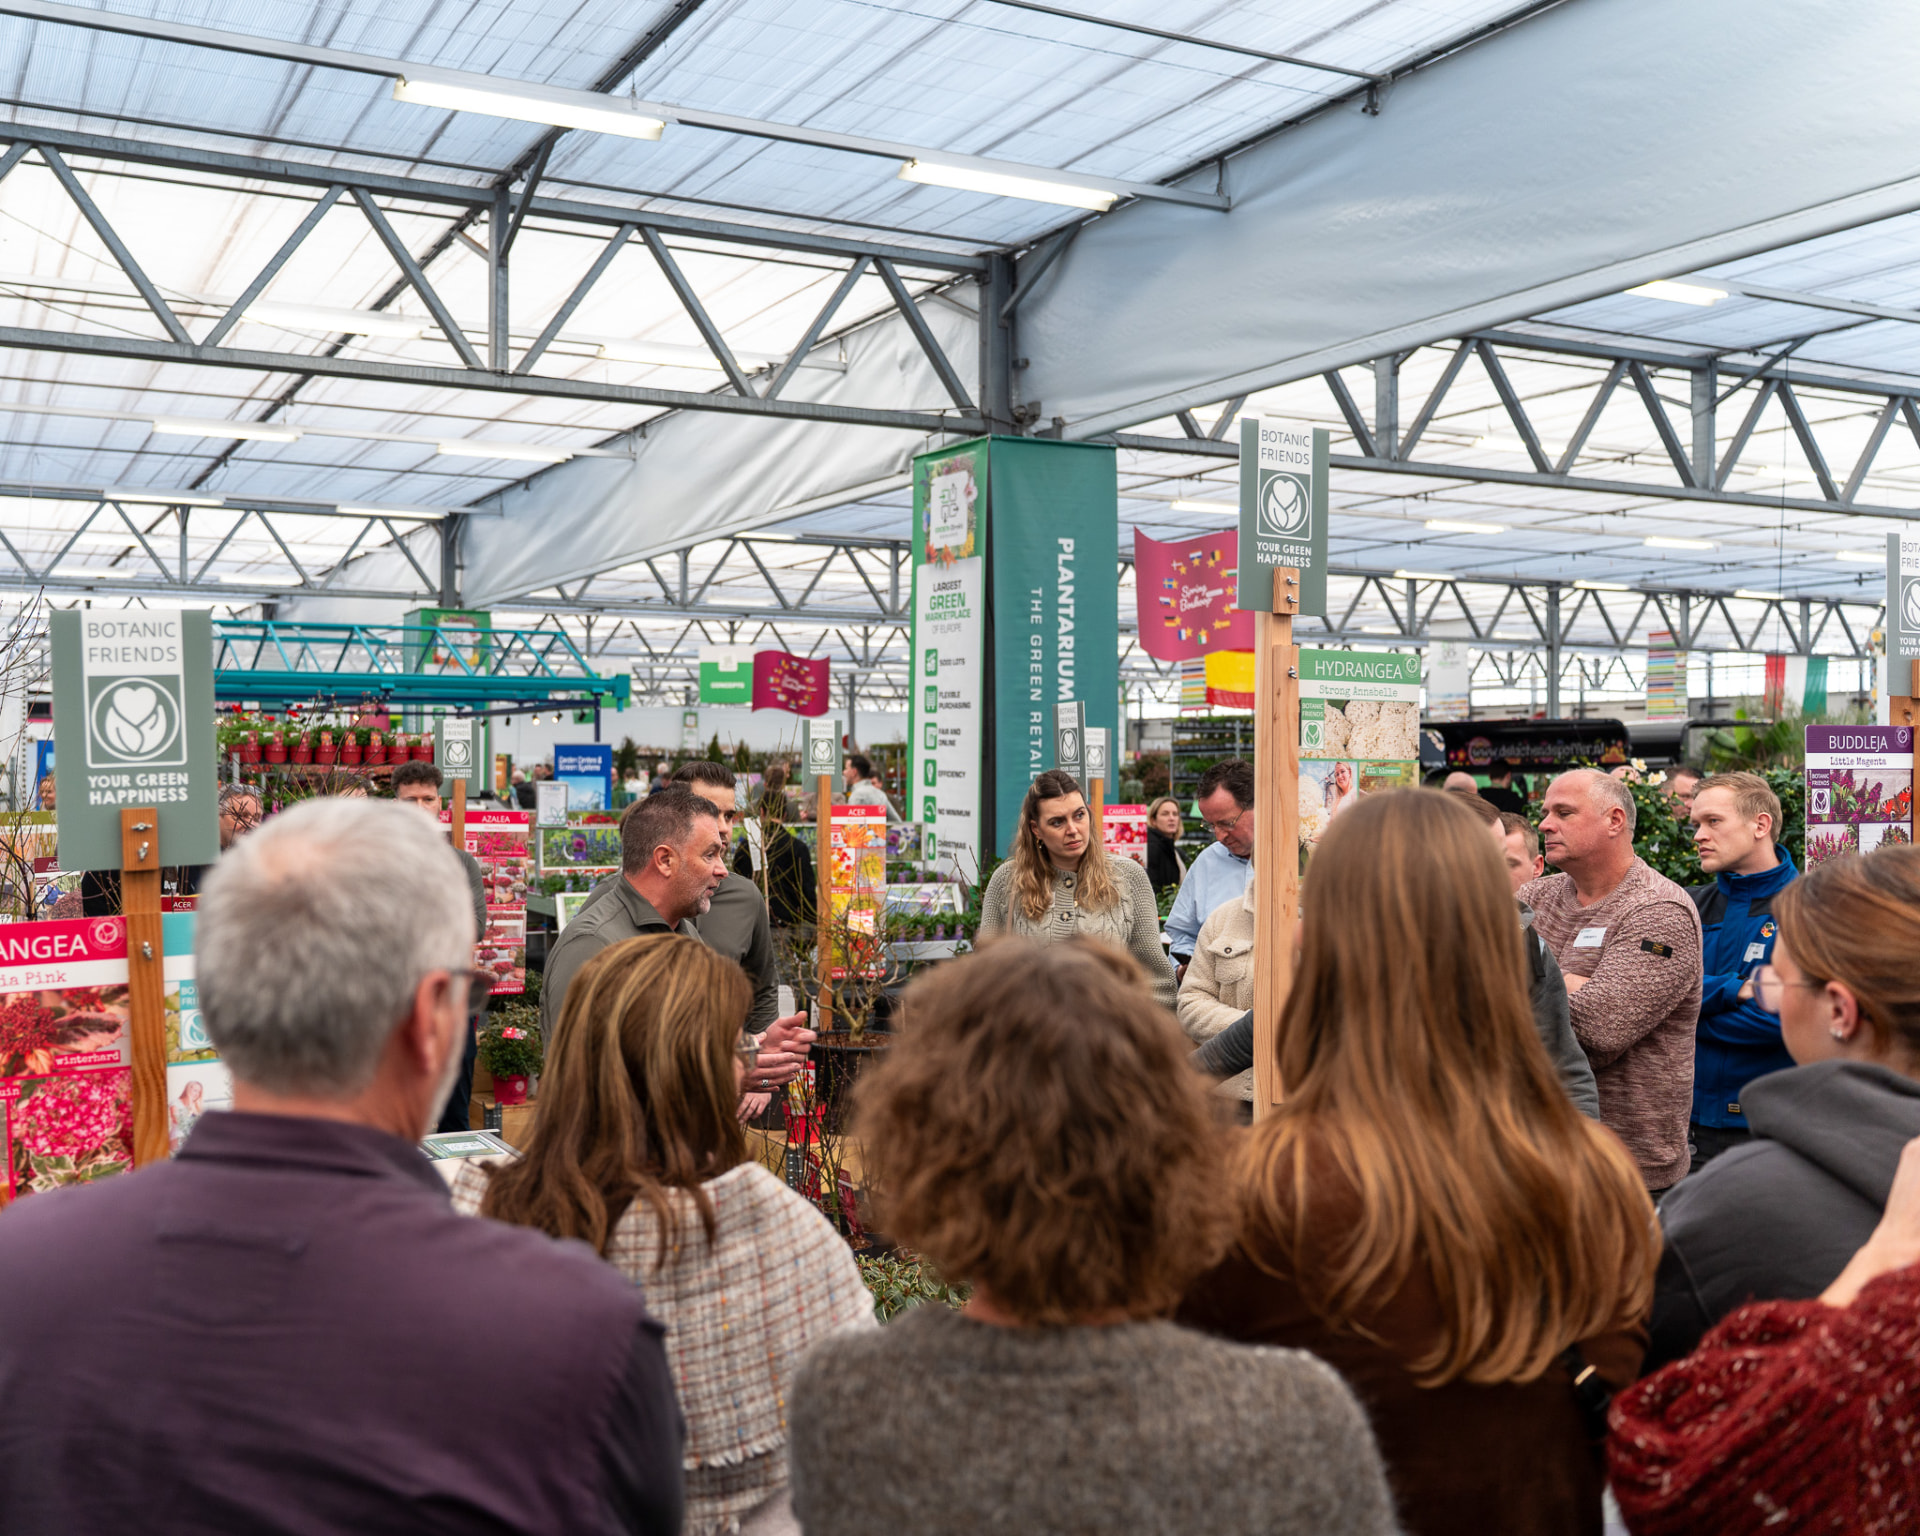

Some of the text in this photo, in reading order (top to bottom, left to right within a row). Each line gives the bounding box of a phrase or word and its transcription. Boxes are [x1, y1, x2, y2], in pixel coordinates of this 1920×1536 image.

[1261, 429, 1310, 448] BOTANIC
[1261, 447, 1310, 465] FRIENDS
[1256, 541, 1312, 556] YOUR GREEN
[1256, 552, 1311, 568] HAPPINESS
[933, 580, 962, 593] LARGEST
[929, 591, 966, 611] GREEN
[925, 608, 972, 622] MARKETPLACE
[1057, 537, 1075, 700] PLANTARIUM
[87, 621, 176, 639] BOTANIC
[932, 622, 963, 635] OF EUROPE
[1899, 637, 1916, 646] YOUR
[88, 646, 178, 663] FRIENDS
[1315, 660, 1403, 680] HYDRANGEA
[1030, 587, 1043, 780] THE GREEN RETAIL
[938, 691, 961, 699] FLEXIBLE
[1319, 685, 1398, 698] Strong Annabelle
[938, 701, 972, 710] PURCHASING
[1059, 706, 1077, 714] BOTANIC
[1302, 702, 1324, 710] BOTANIC
[1302, 710, 1324, 718] FRIENDS
[938, 728, 949, 736] FAIR
[938, 739, 956, 747] ONLINE
[1829, 735, 1888, 752] BUDDLEJA
[1830, 756, 1887, 767] Little Magenta
[87, 772, 189, 789] YOUR GREEN
[938, 770, 966, 779] EFFICIENCY
[89, 787, 189, 805] HAPPINESS
[847, 808, 866, 816] ACER
[946, 808, 971, 818] MINIMUM
[481, 815, 511, 823] AZALEA
[173, 901, 192, 909] ACER
[25, 970, 67, 985] Pink
[55, 1051, 120, 1066] winterhard
